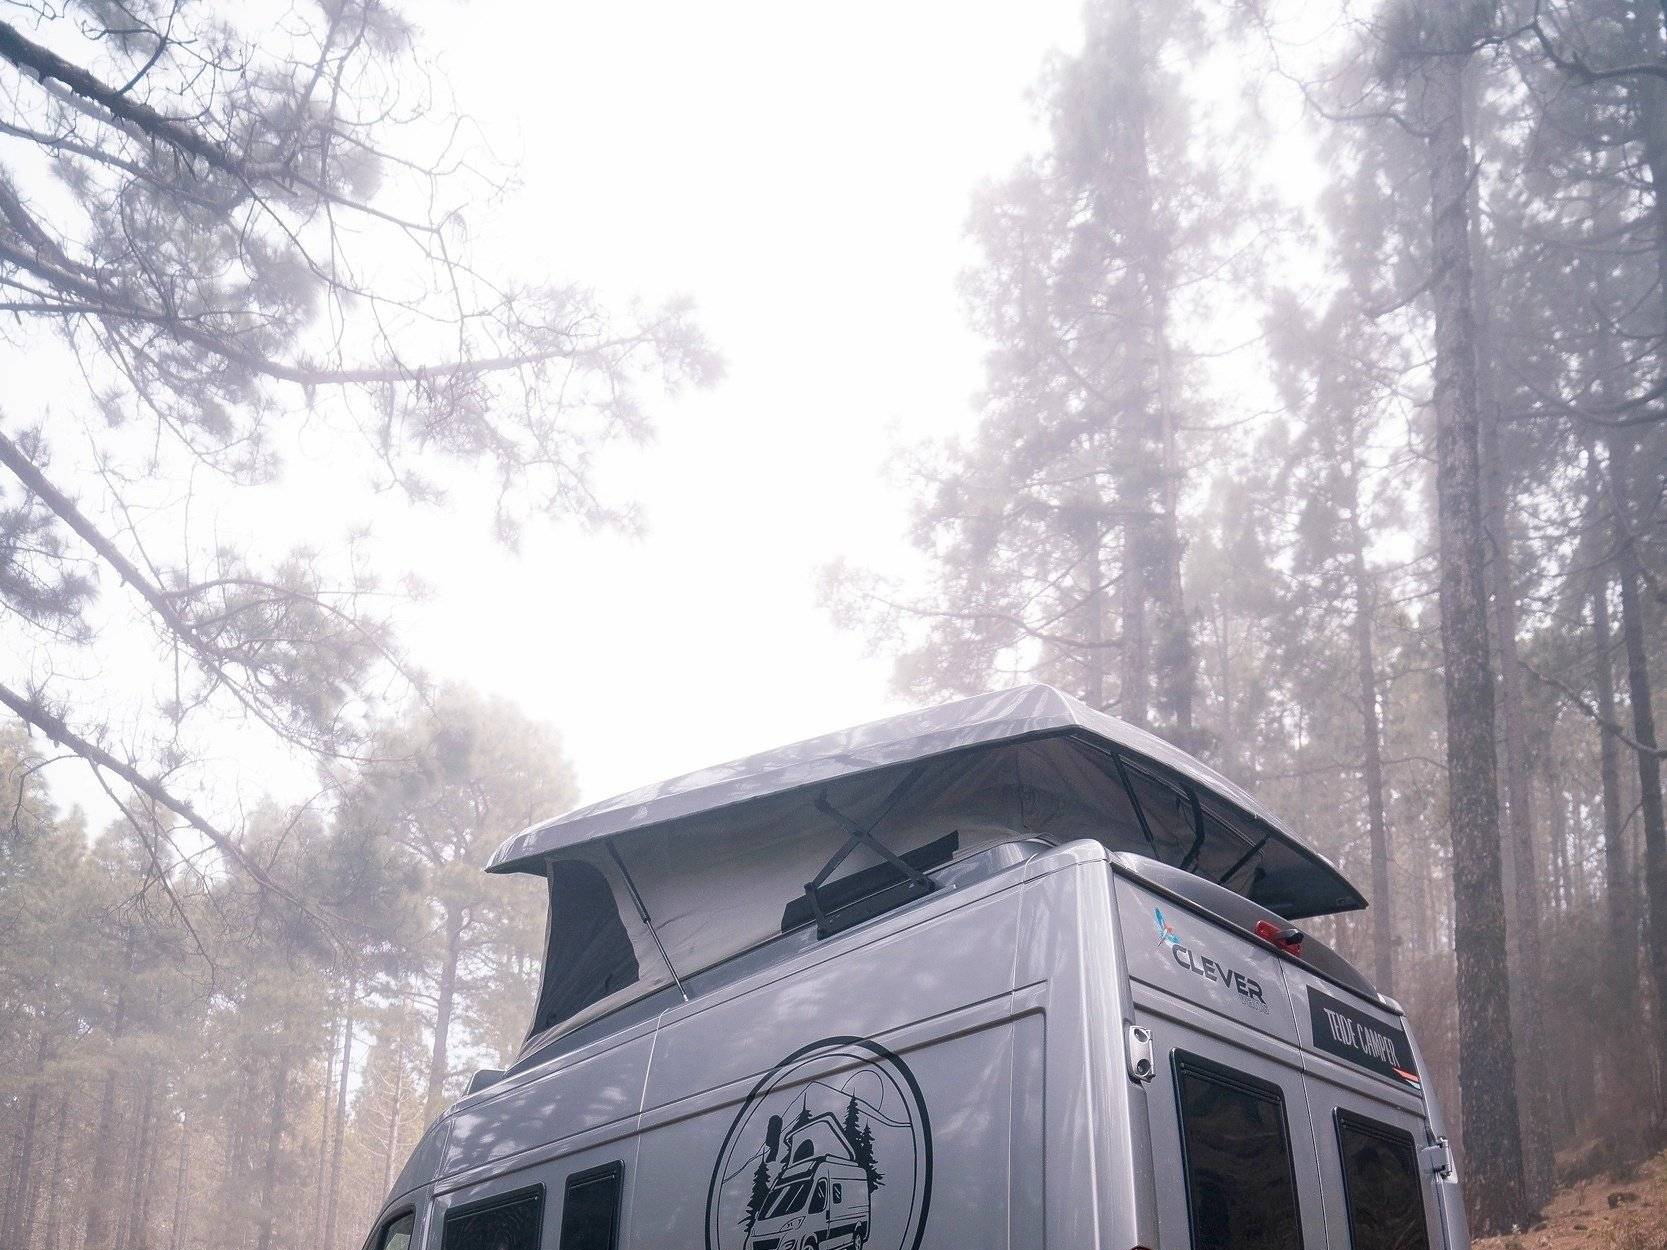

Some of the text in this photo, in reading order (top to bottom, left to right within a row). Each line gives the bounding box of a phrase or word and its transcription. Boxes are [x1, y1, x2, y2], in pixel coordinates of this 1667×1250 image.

[1171, 945, 1266, 1004] CLEVER
[1323, 1008, 1400, 1067] TEIDE CAMPER
